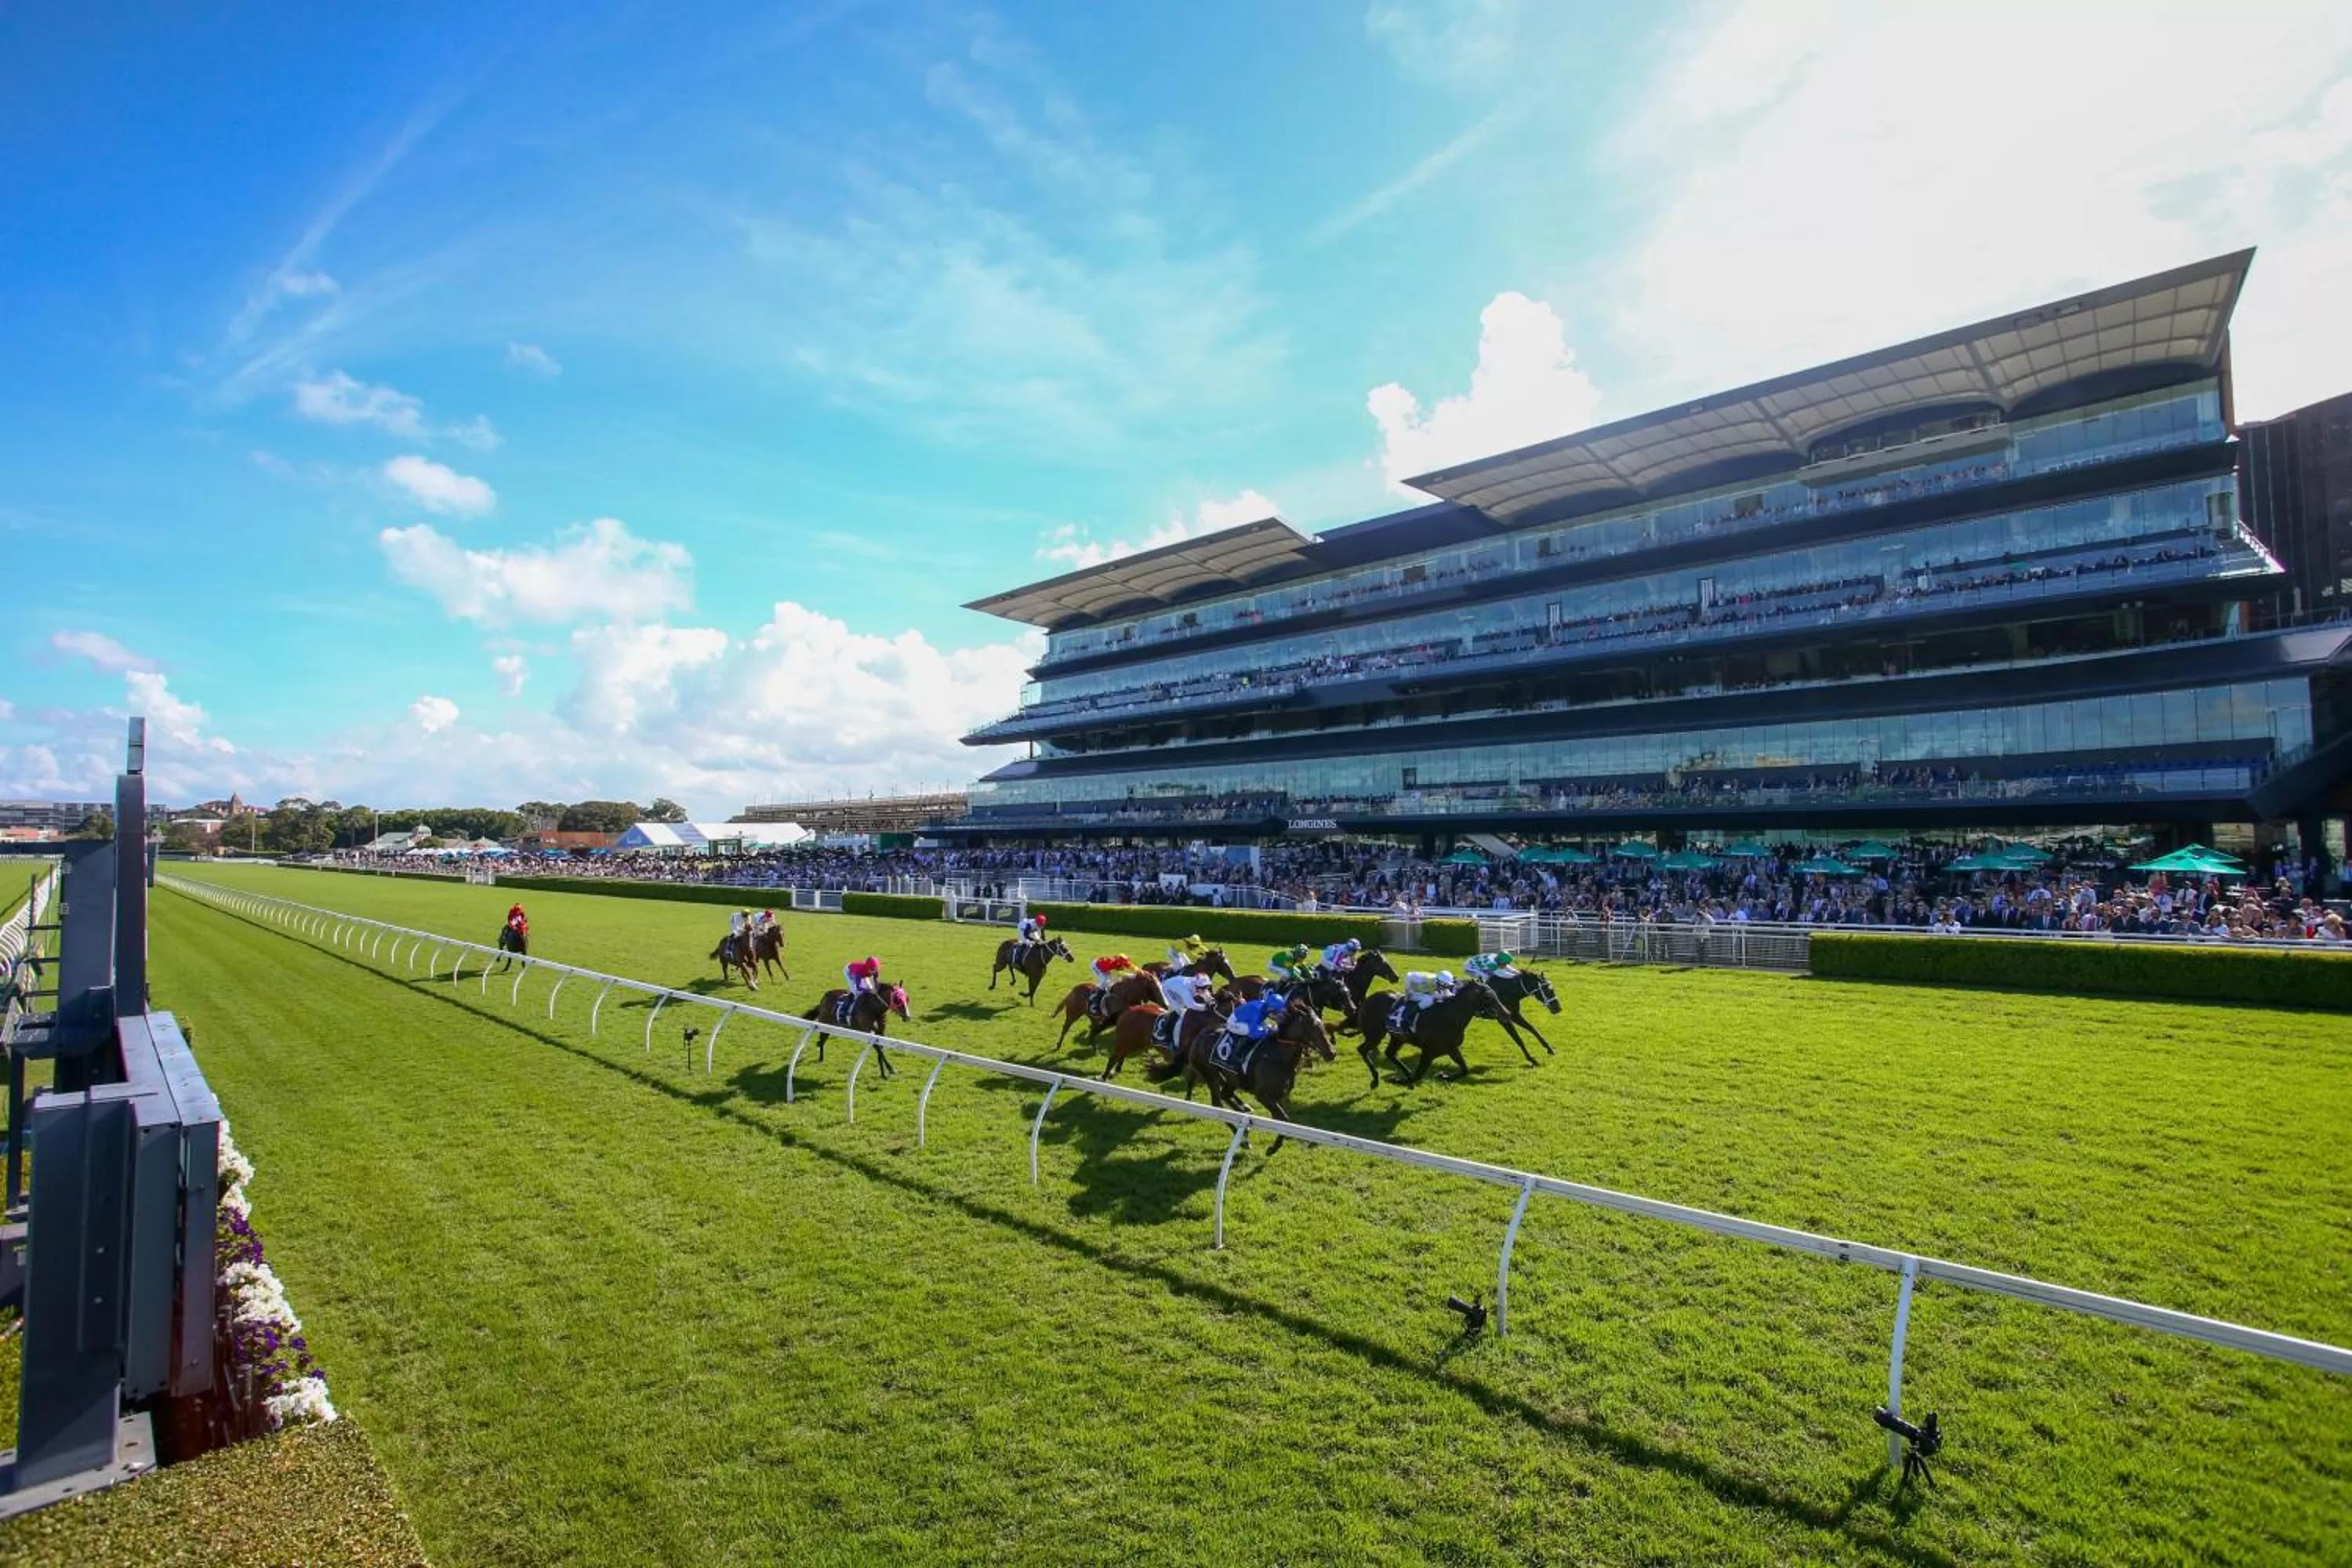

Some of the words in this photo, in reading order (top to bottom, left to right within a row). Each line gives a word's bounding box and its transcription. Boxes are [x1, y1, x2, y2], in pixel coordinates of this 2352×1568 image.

[1288, 819, 1337, 829] LONGINES
[1388, 1005, 1406, 1028] 4
[1217, 1033, 1233, 1061] 6
